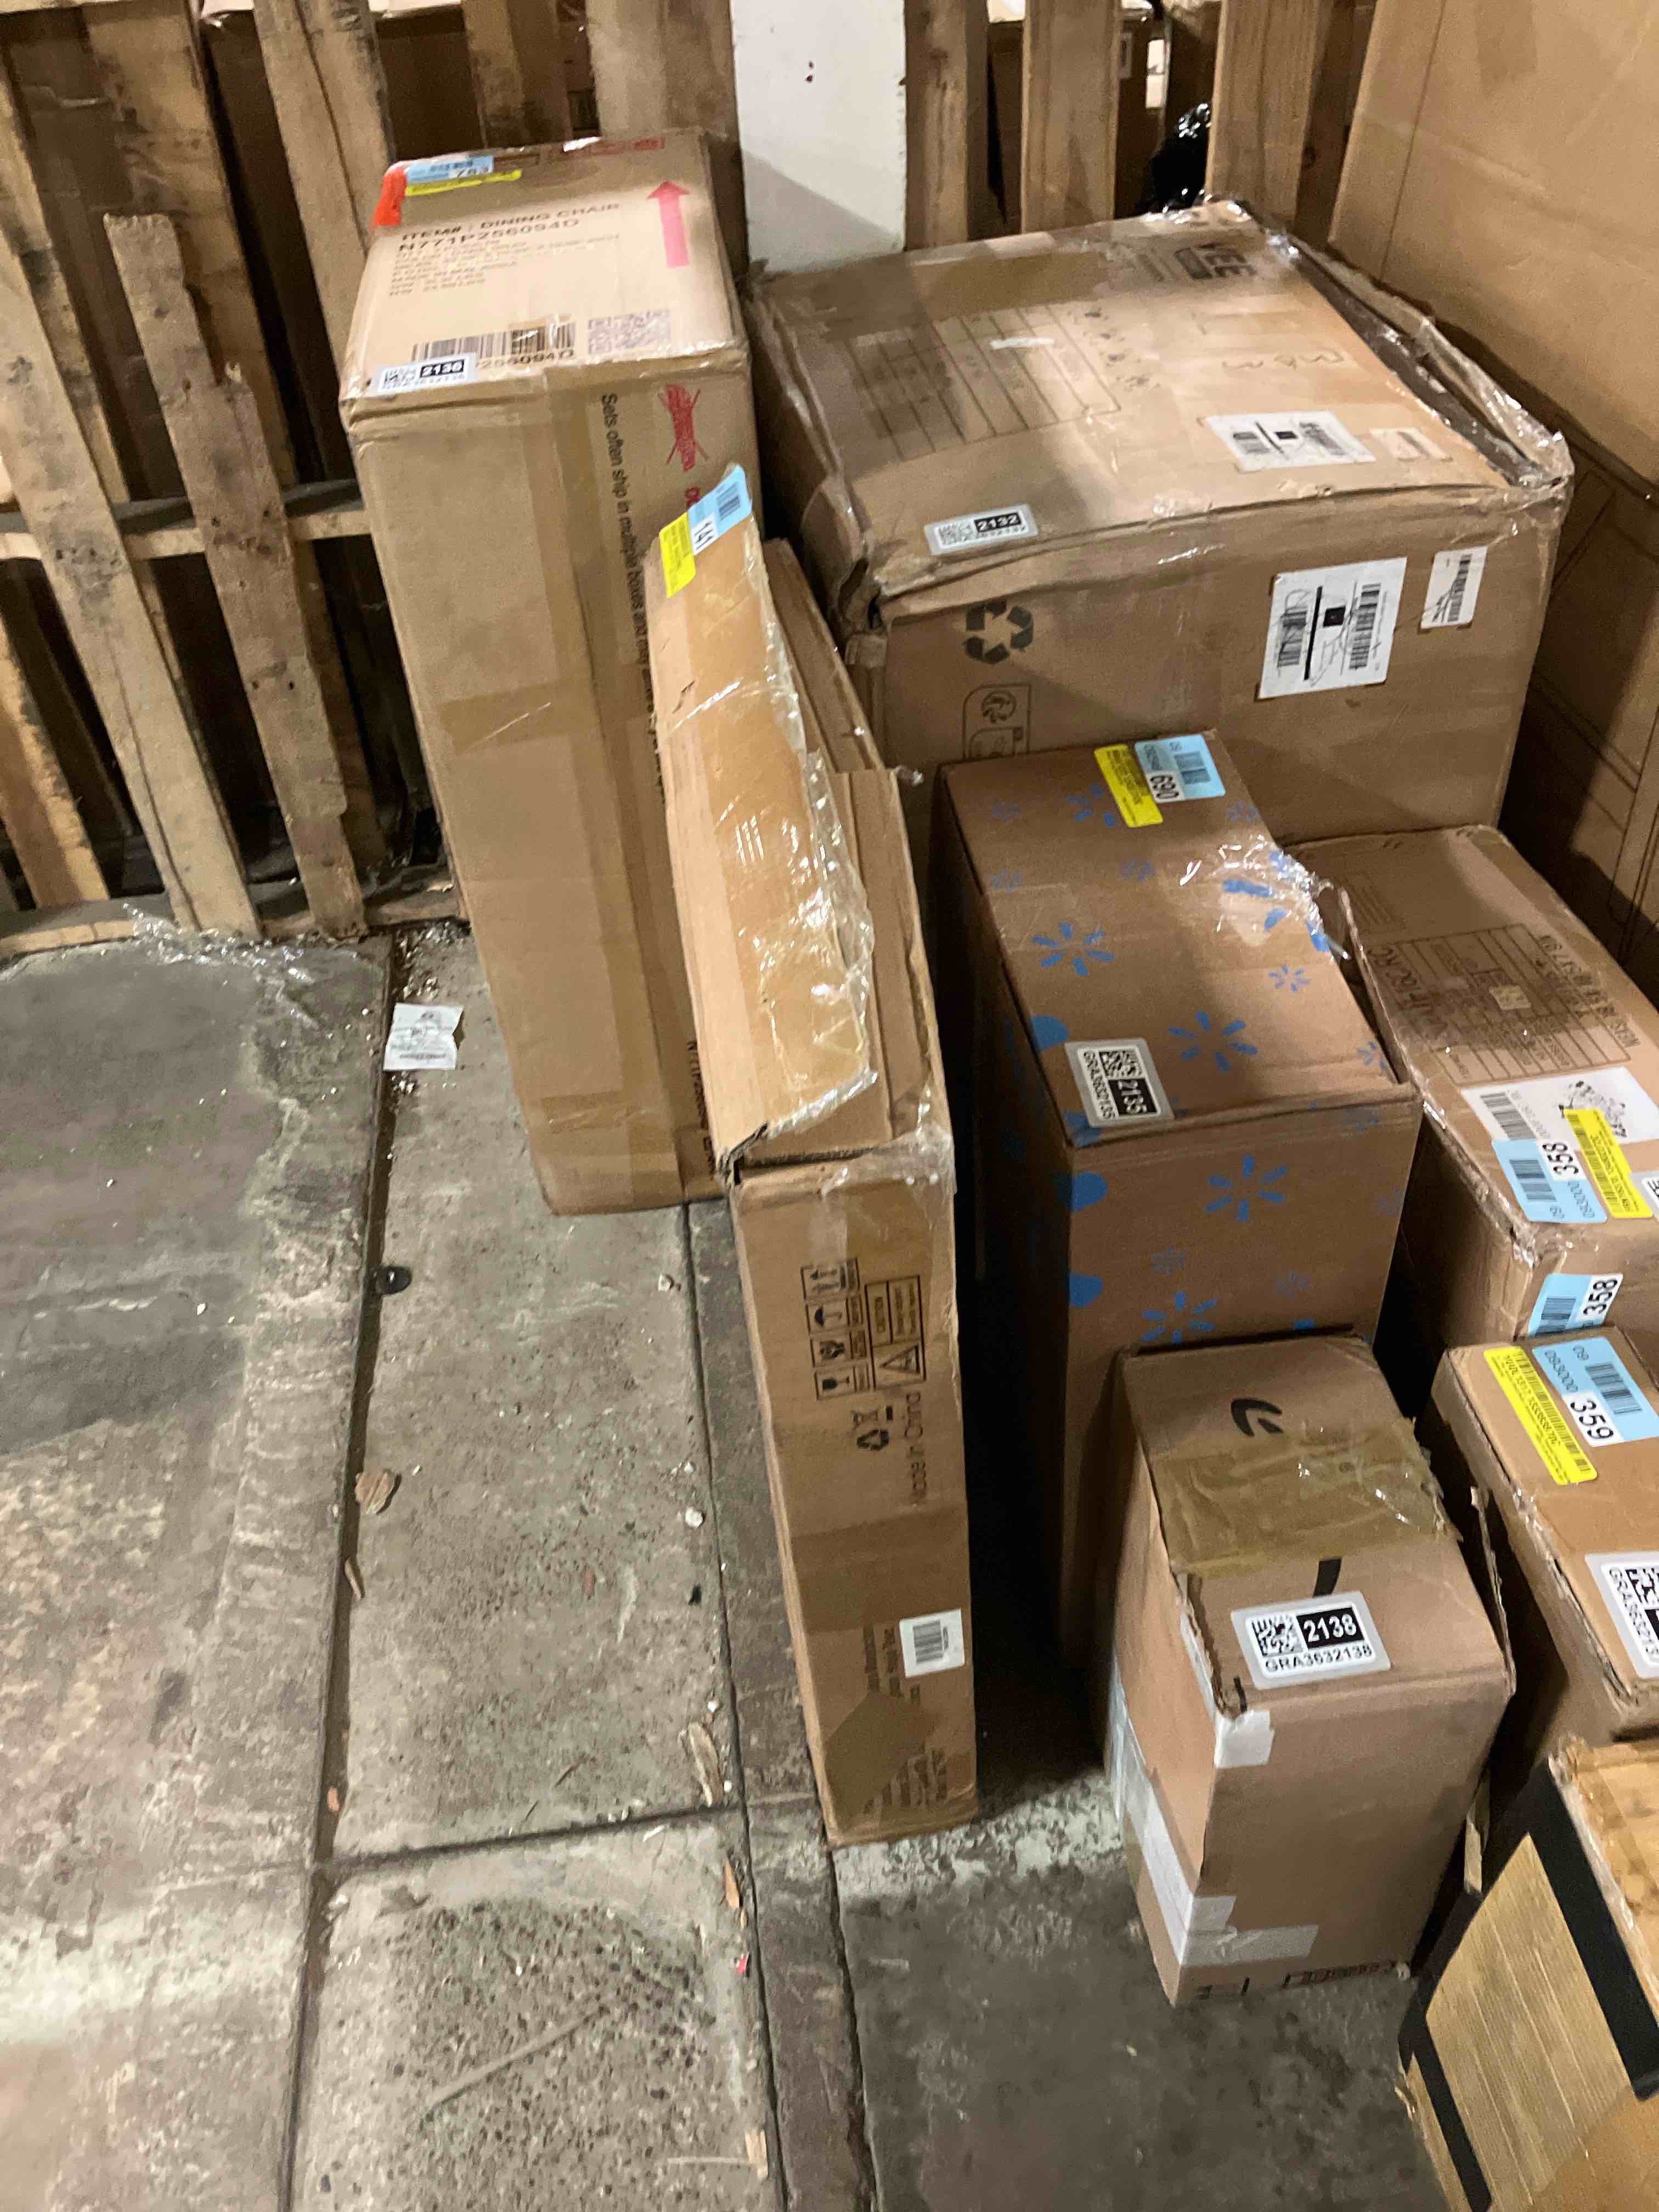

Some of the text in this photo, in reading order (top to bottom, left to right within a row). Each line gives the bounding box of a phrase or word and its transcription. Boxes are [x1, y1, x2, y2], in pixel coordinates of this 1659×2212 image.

[480, 213, 550, 229] DINING
[557, 203, 619, 218] CHAIR
[606, 430, 624, 467] often
[612, 468, 630, 498] ship
[617, 500, 630, 514] in
[977, 514, 1019, 532] 2132
[1117, 1079, 1148, 1114] 2135
[1542, 1142, 1579, 1175] 358
[1582, 1279, 1618, 1314] 358
[1570, 1399, 1615, 1440] 359
[1302, 1613, 1357, 1643] 2138
